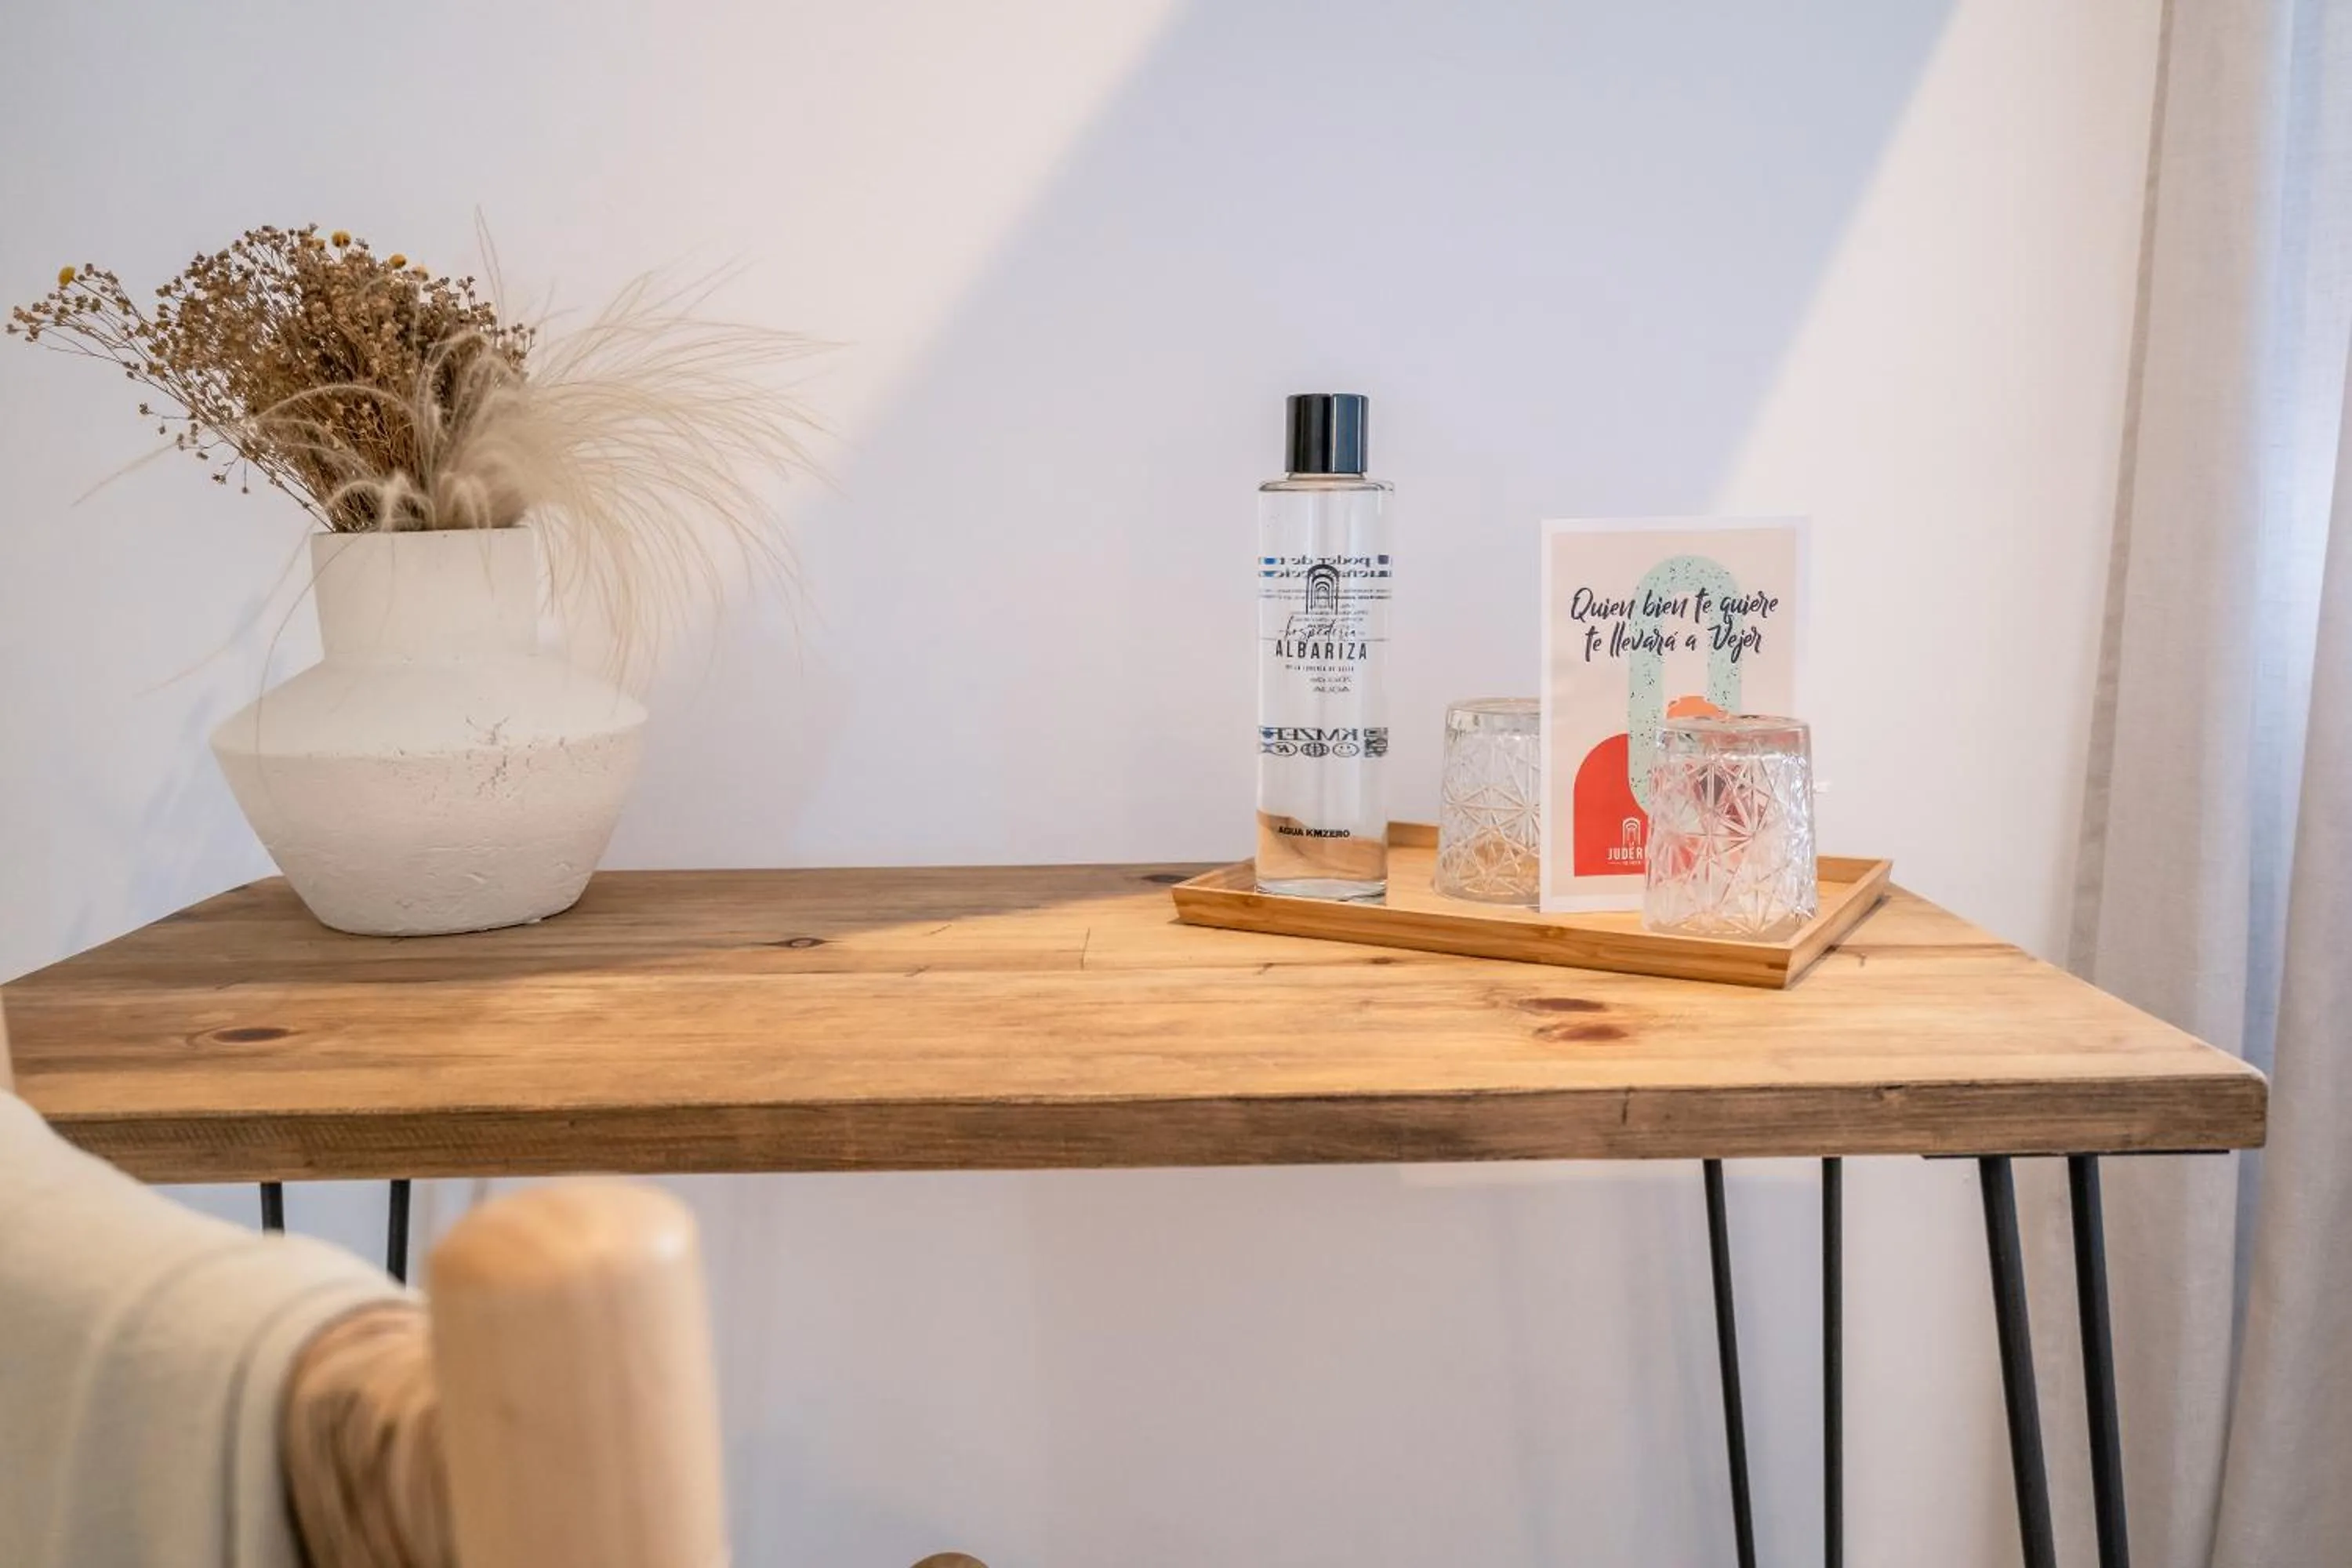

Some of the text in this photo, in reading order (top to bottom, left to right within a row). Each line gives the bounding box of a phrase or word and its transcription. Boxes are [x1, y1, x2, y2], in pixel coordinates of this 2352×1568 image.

[1570, 587, 1779, 624] Quien bien te quiere
[1276, 639, 1367, 660] ALBARIZA
[1584, 622, 1762, 663] te llevará a Vejer
[1305, 828, 1351, 838] KMZERO
[1605, 847, 1647, 860] JUDER
